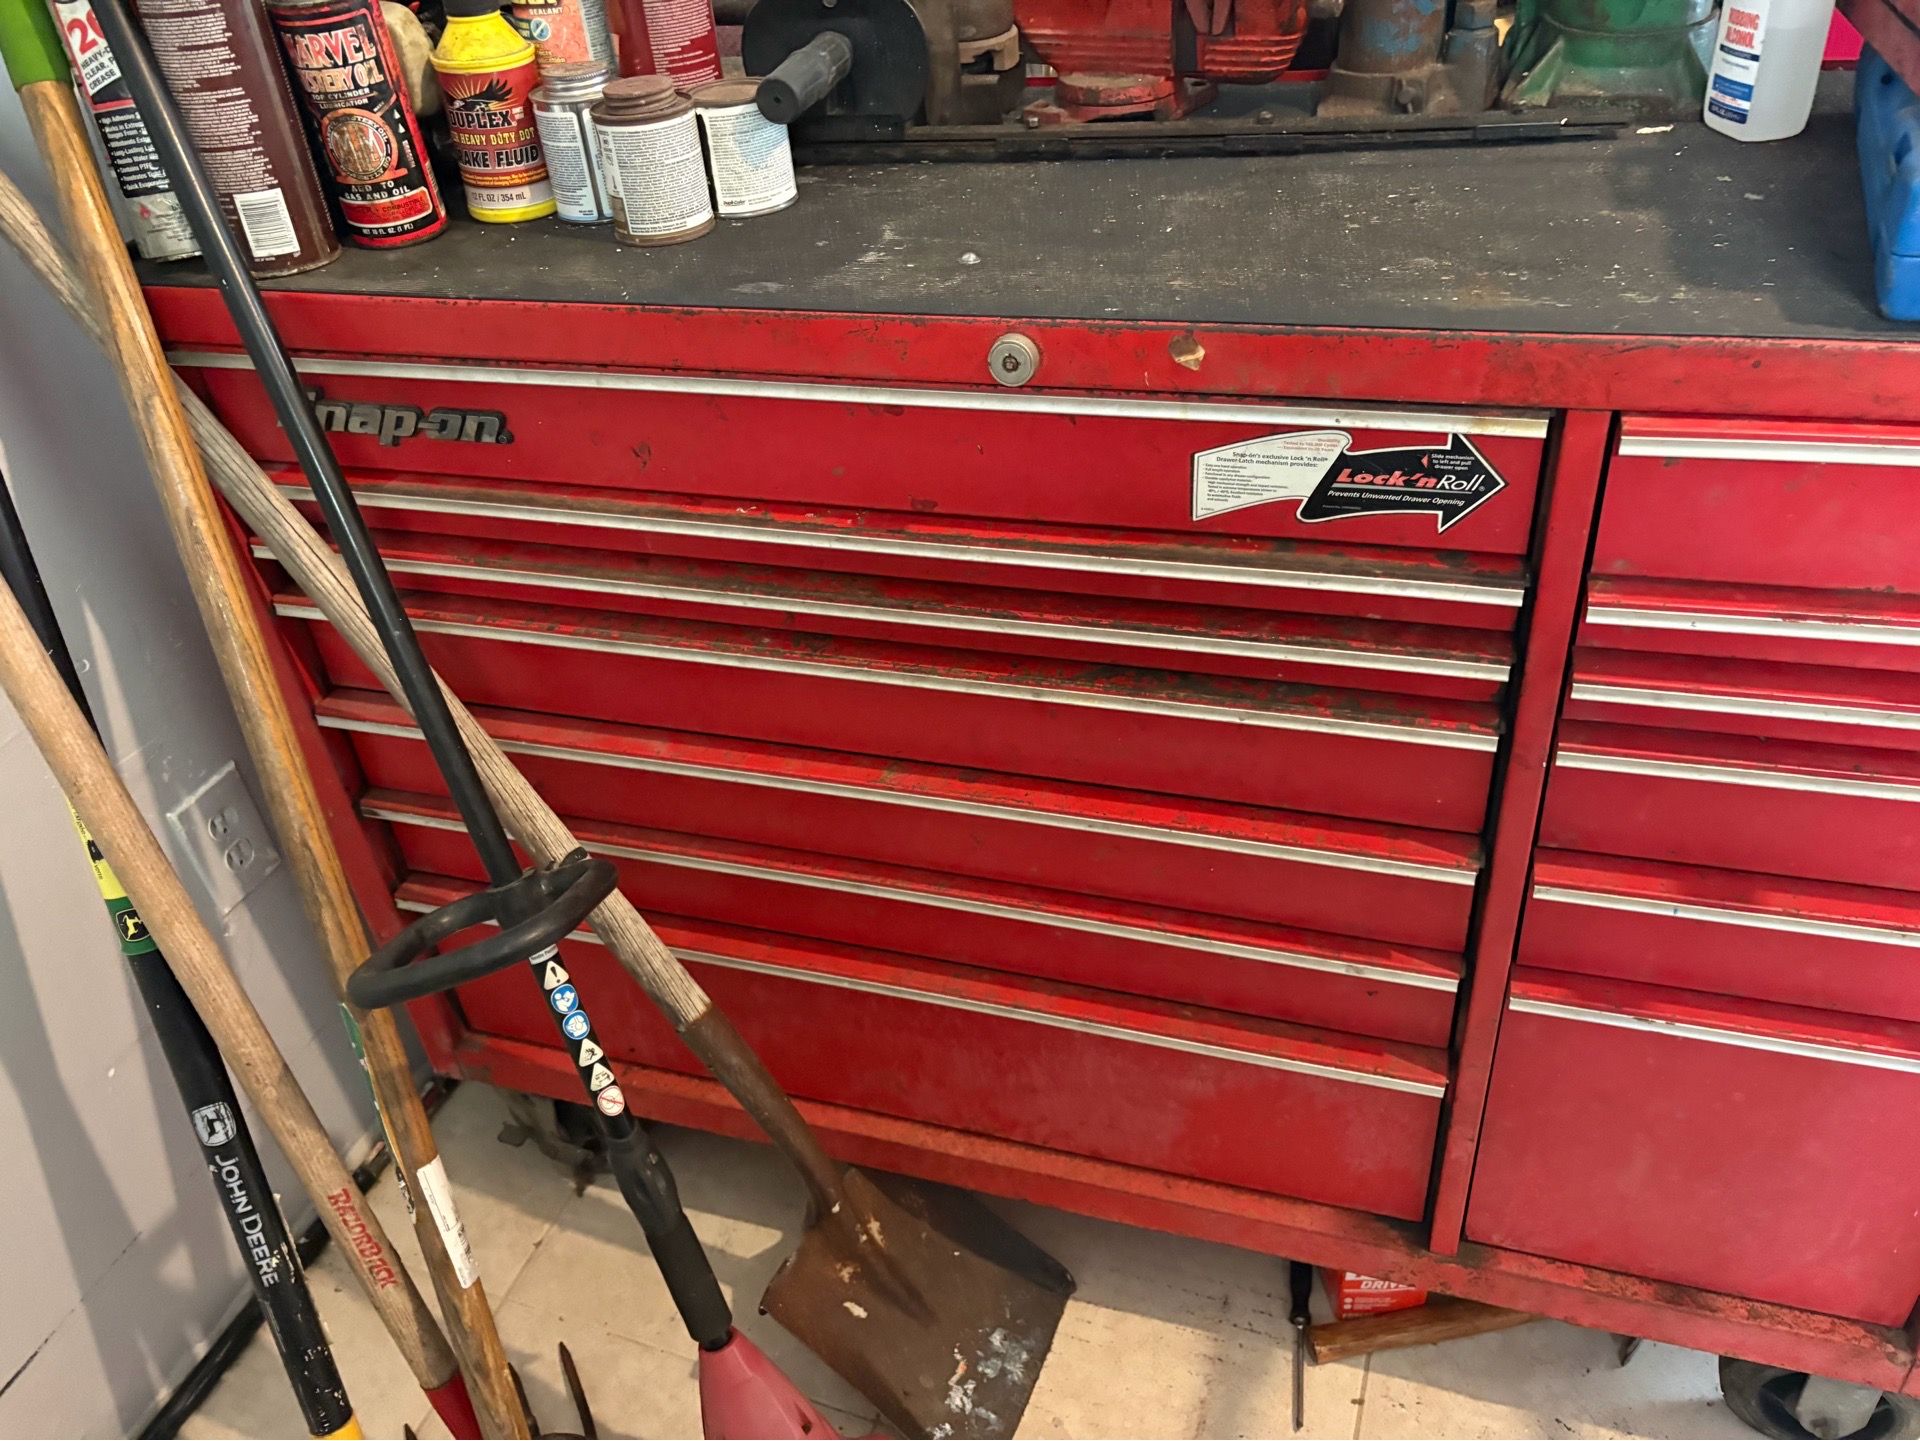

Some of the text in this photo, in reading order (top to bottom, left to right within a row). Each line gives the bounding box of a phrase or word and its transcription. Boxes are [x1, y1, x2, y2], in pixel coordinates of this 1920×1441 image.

[529, 7, 563, 16] SEALANT
[282, 24, 377, 68] MARVEL
[89, 69, 117, 90] GREASE
[354, 60, 385, 88] OIL
[328, 87, 371, 101] CYLINDER
[448, 109, 513, 129] DUPLEX
[460, 131, 487, 145] HEAVY
[490, 132, 516, 145] DUTY
[520, 127, 535, 140] DOT
[495, 144, 540, 169] FLUID
[380, 180, 395, 189] TO
[345, 186, 411, 201] GAS AND OIL
[501, 193, 514, 202] 354
[516, 191, 527, 200] mL
[304, 387, 502, 446] nap-on
[1262, 453, 1289, 461] exclusive
[1290, 460, 1318, 468] provides:
[1446, 454, 1476, 462] mechanism
[1327, 490, 1466, 507] Prevents Unwanted Drawer Opening
[214, 1154, 280, 1288] JOHN DEERE
